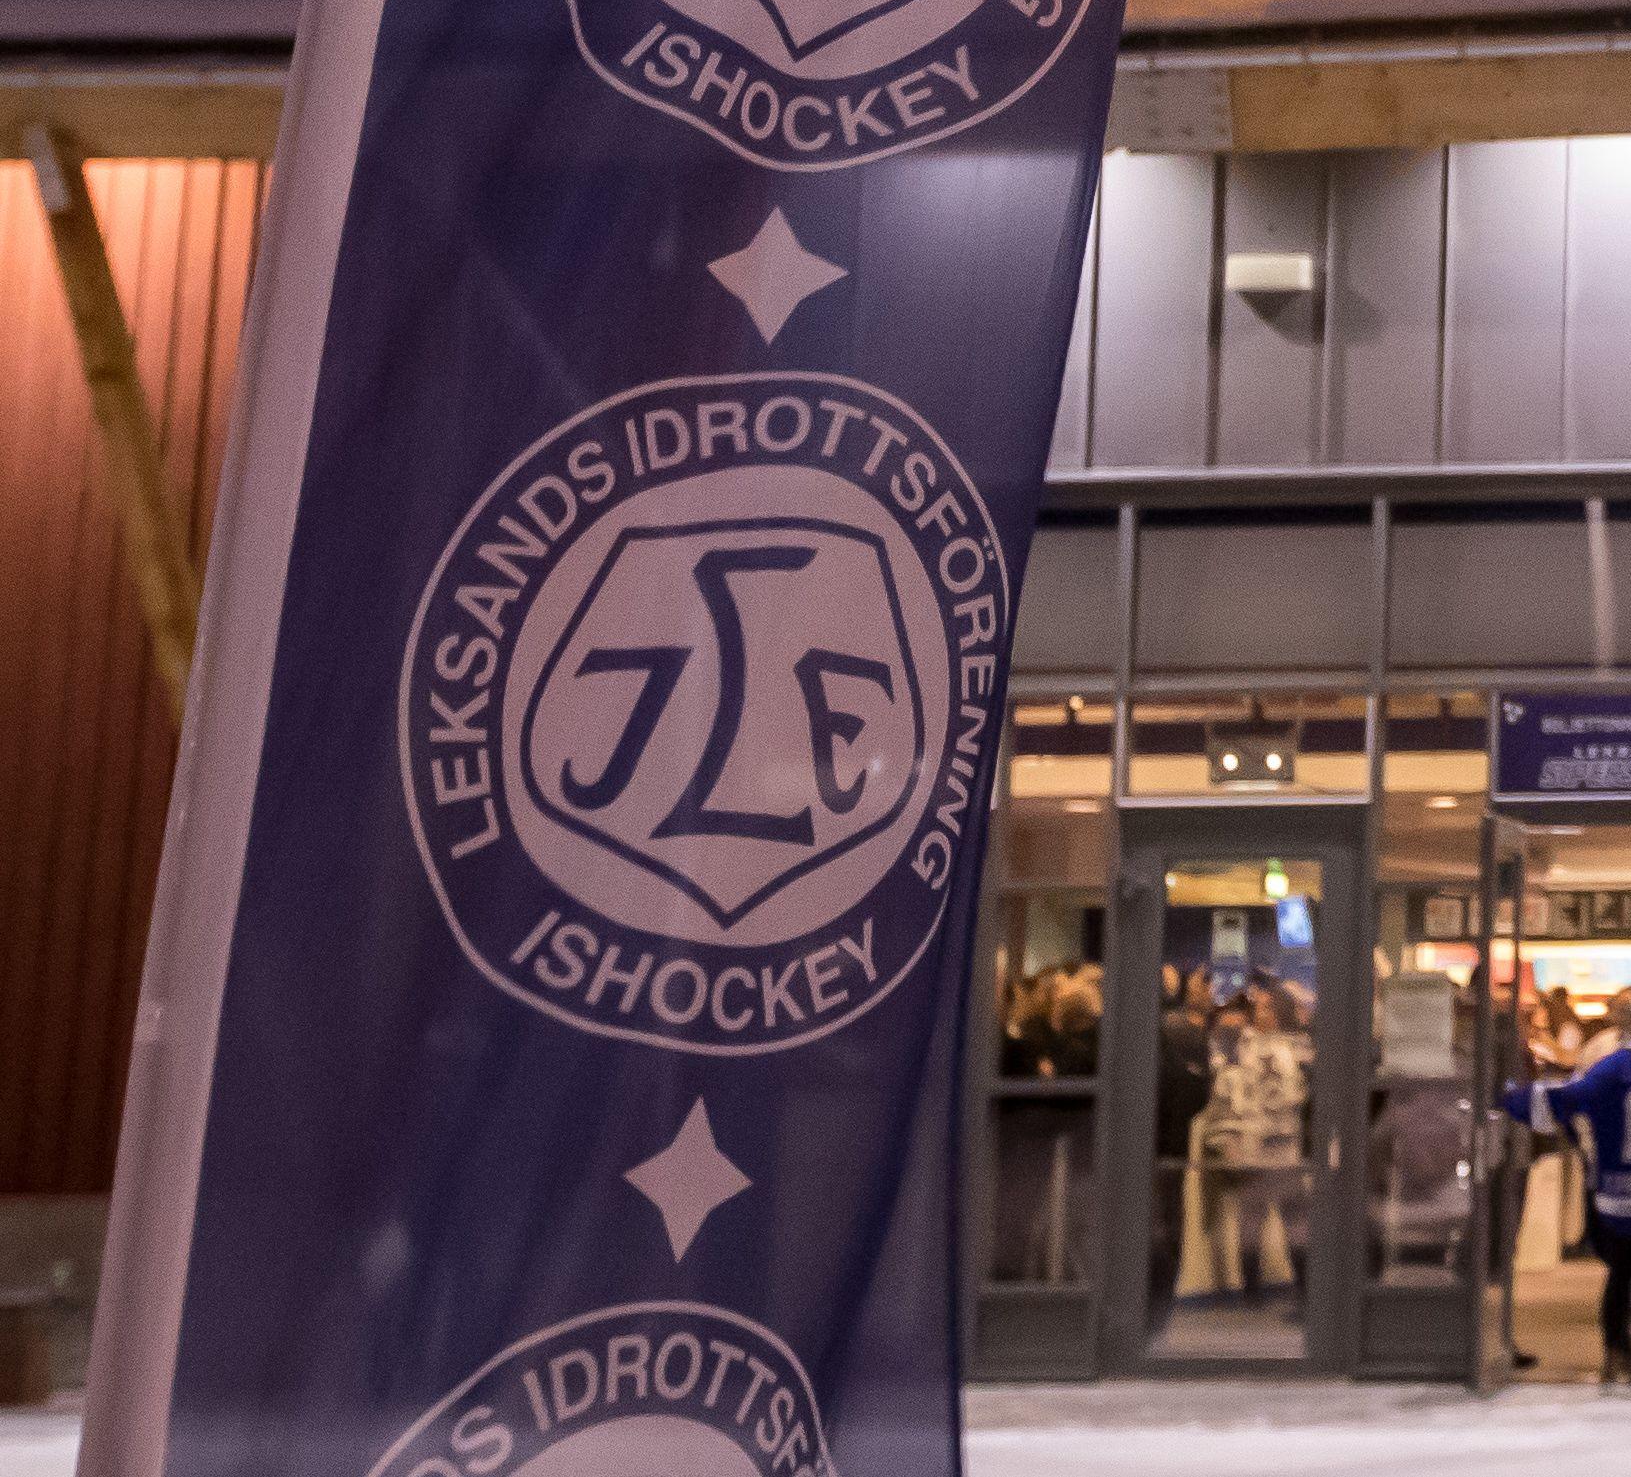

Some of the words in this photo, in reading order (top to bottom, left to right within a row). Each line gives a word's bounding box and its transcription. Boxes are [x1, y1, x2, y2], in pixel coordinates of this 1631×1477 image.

[621, 21, 983, 151] ISHOCKEY
[428, 440, 617, 860] LEKSANDS
[624, 395, 998, 891] IDROTTSFÖRENING
[510, 910, 880, 1031] ISHOCKEY
